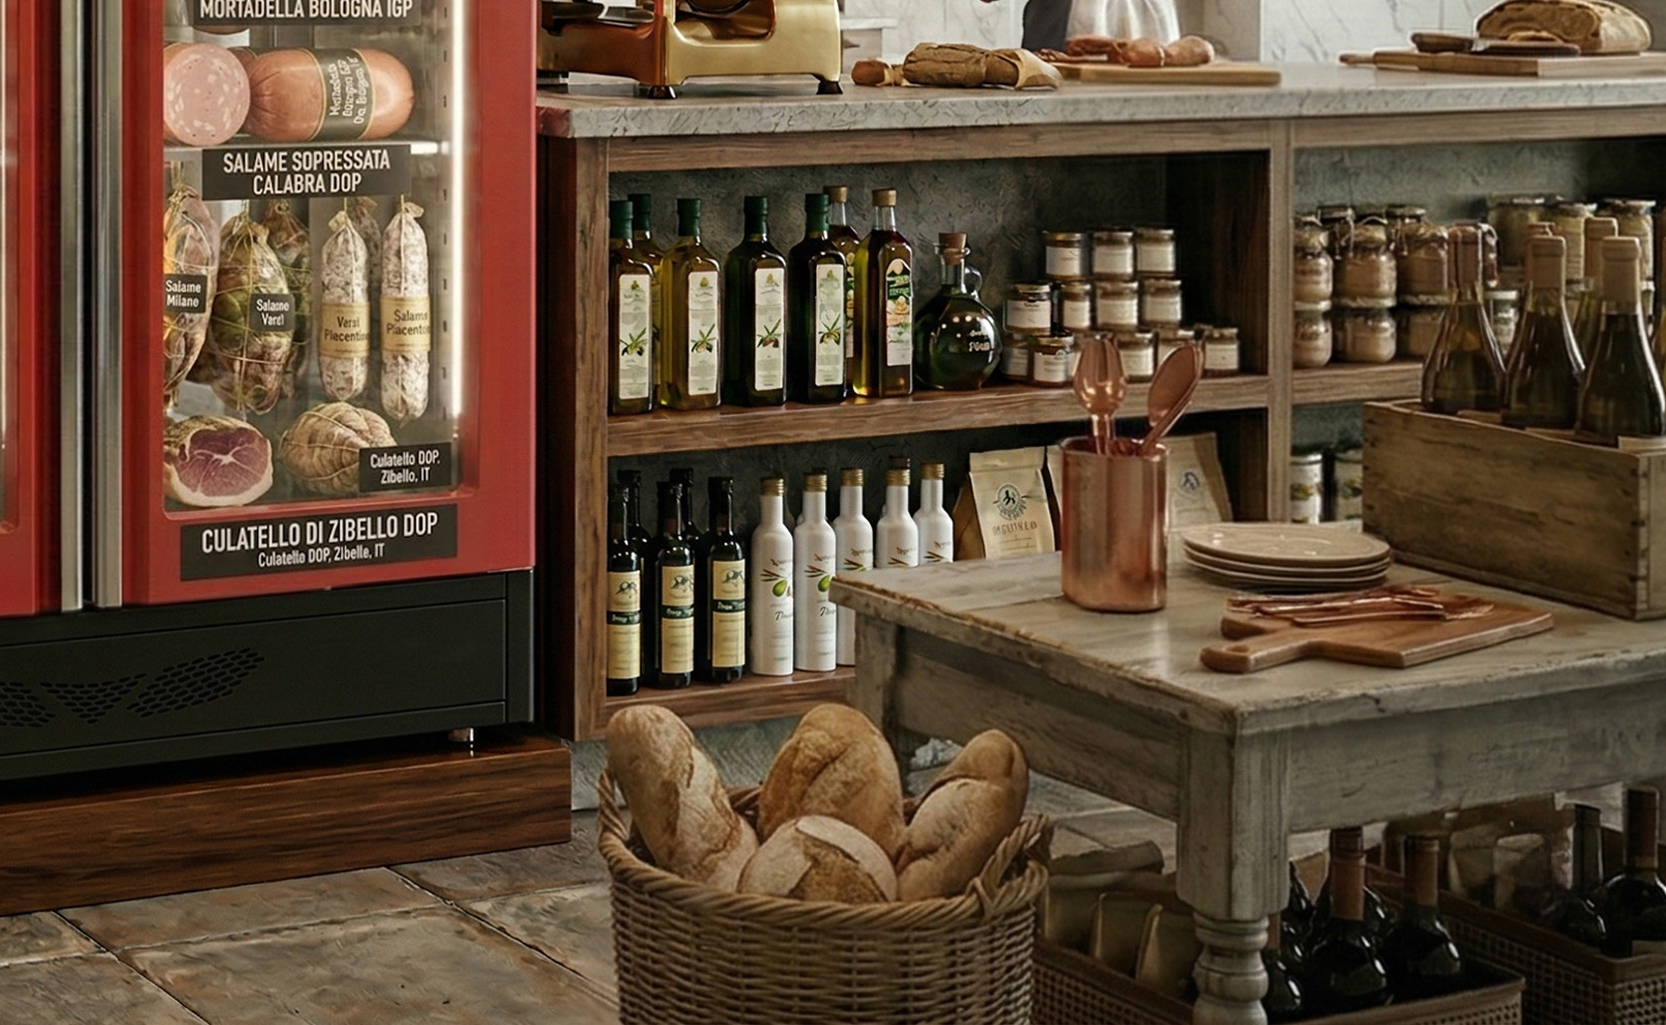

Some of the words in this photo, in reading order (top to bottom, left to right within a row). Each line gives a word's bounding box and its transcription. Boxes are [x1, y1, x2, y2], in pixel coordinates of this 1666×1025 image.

[223, 152, 287, 174] SALAME
[292, 149, 391, 172] SOPRESSATA
[253, 174, 326, 195] CALABRA
[330, 172, 362, 193] DOP
[421, 468, 430, 482] IT
[202, 522, 301, 554] CULATELLO
[306, 522, 323, 545] DI
[329, 515, 397, 543] ZIBELLO
[403, 512, 438, 537] DOP
[374, 543, 385, 558] IT
